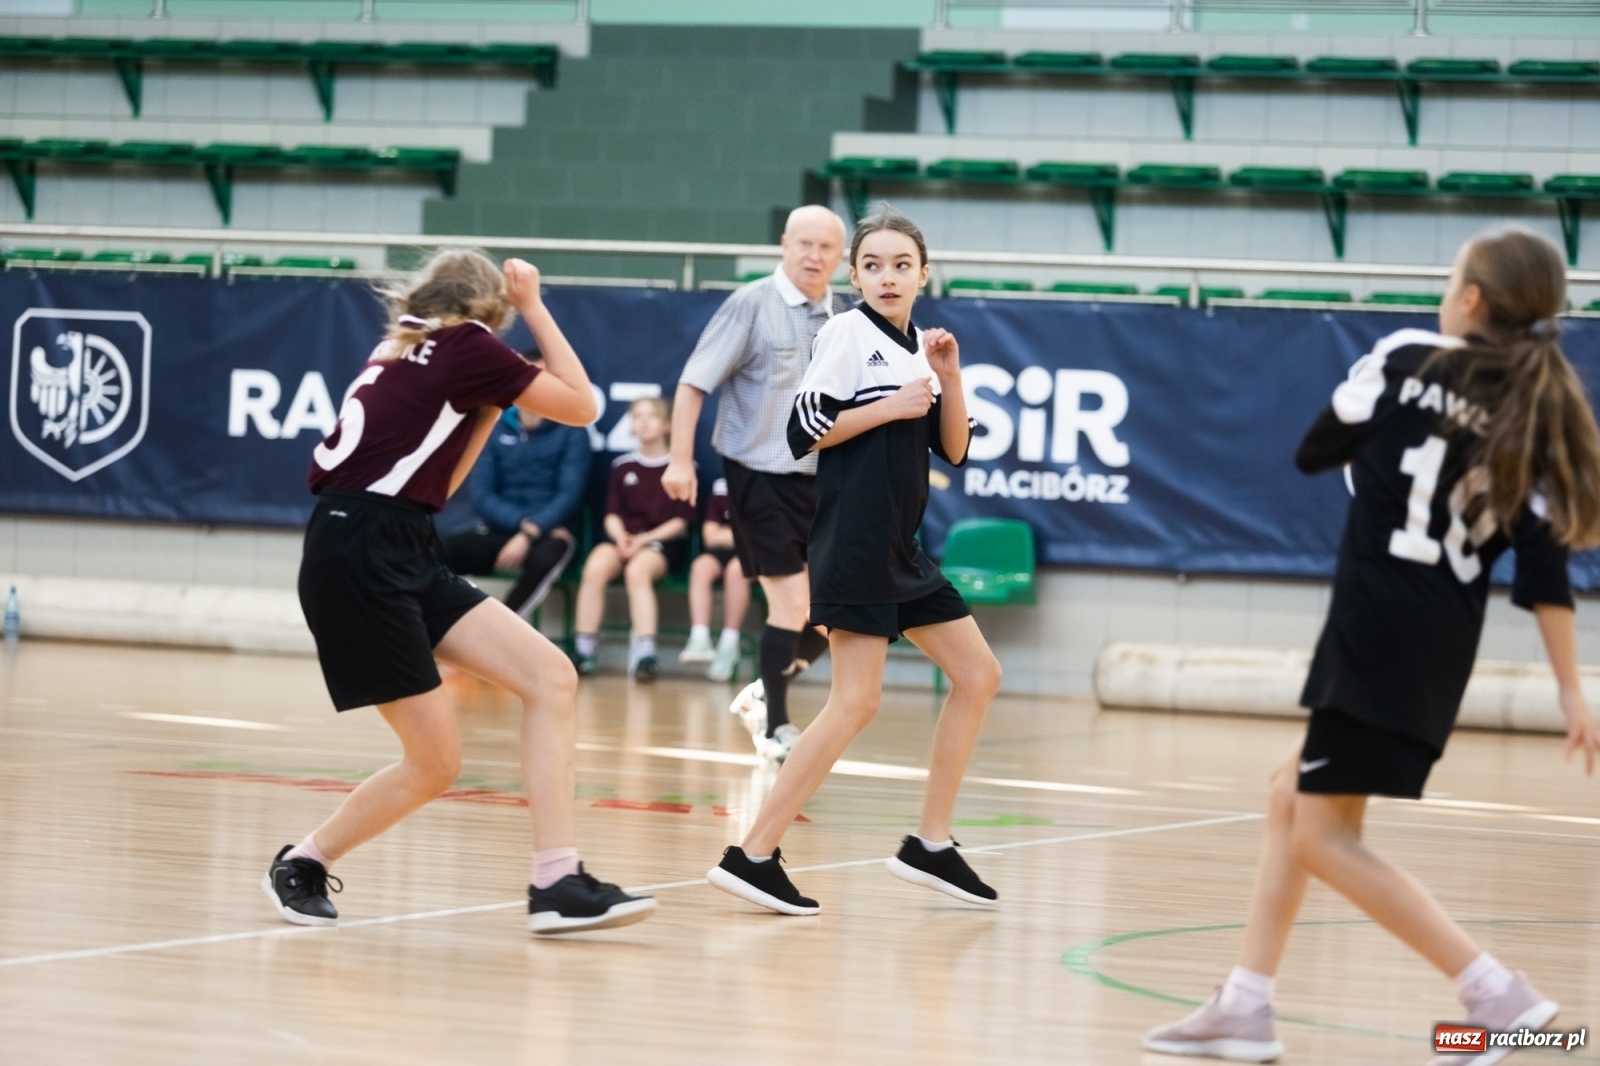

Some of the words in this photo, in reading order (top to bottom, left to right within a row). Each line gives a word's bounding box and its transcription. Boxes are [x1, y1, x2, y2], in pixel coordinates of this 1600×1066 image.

[313, 365, 385, 471] 5
[958, 363, 1131, 468] SiR
[964, 464, 1130, 504] RACIBÓRZ
